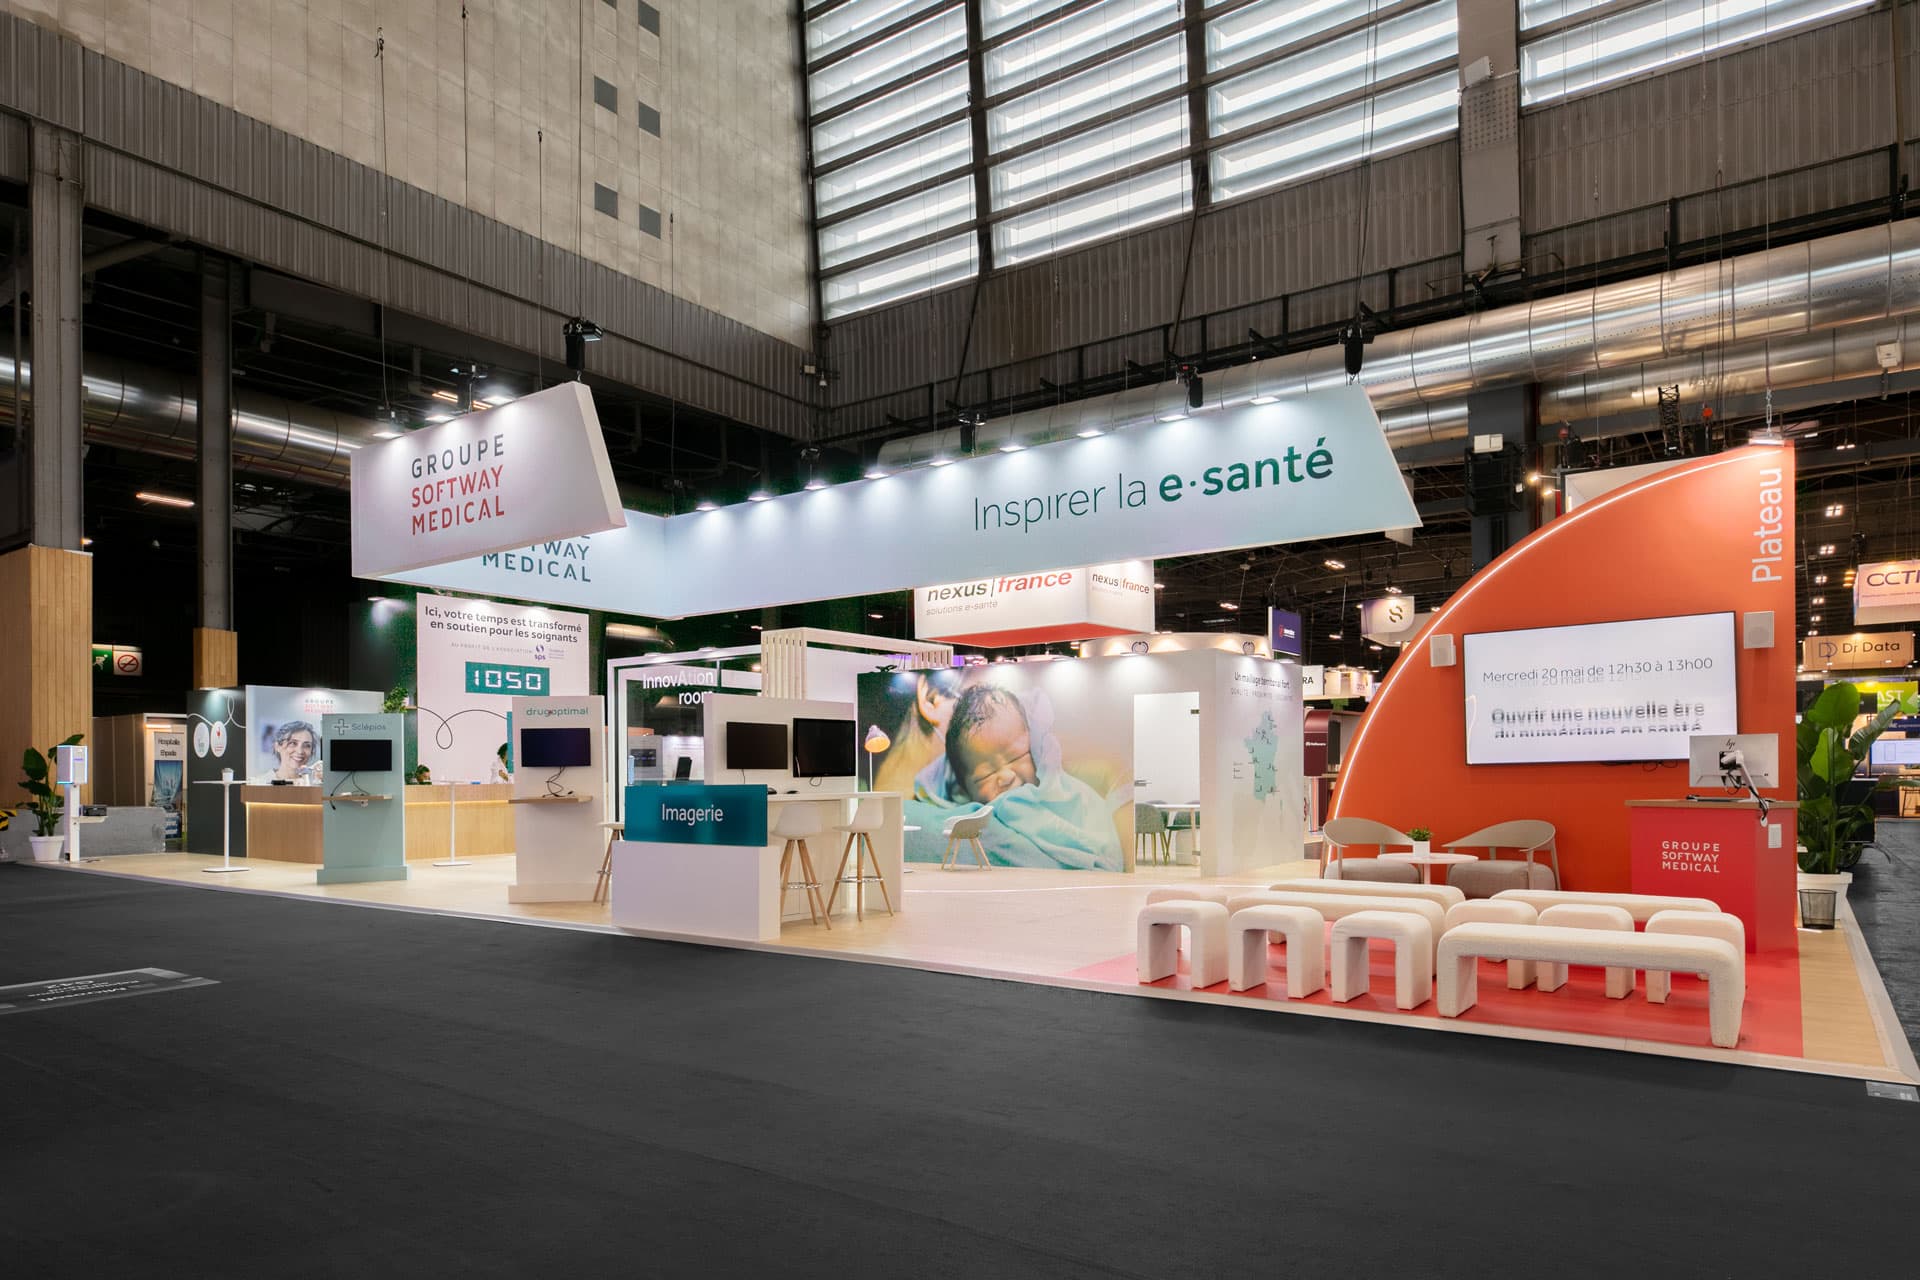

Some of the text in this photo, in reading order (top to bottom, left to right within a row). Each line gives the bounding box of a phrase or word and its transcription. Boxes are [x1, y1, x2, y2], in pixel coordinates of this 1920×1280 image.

[412, 434, 504, 478] GROUPE
[412, 464, 503, 508] SOFTWAY
[412, 495, 505, 535] MEDICAL
[975, 485, 1106, 533] Inspirer
[1118, 472, 1146, 509] la
[1752, 467, 1782, 583] Plateau
[482, 552, 591, 582] MEDICAL
[425, 606, 582, 633] Ici, votre temps est transformé
[926, 605, 963, 616] solutions
[430, 621, 578, 643] en soutien pour les soignants
[1842, 643, 1857, 654] Dr
[1863, 641, 1900, 653] Data
[474, 670, 541, 690] 1050
[1483, 657, 1713, 682] Mercredi 20 mai de 12h30 à 13h00
[1492, 699, 1705, 724] Ouvrir une nouvelle ère
[662, 803, 724, 826] Imagerie
[1662, 840, 1720, 852] GROUPE
[1662, 851, 1719, 863] SOFTWAY
[1662, 861, 1720, 873] MEDICAL
